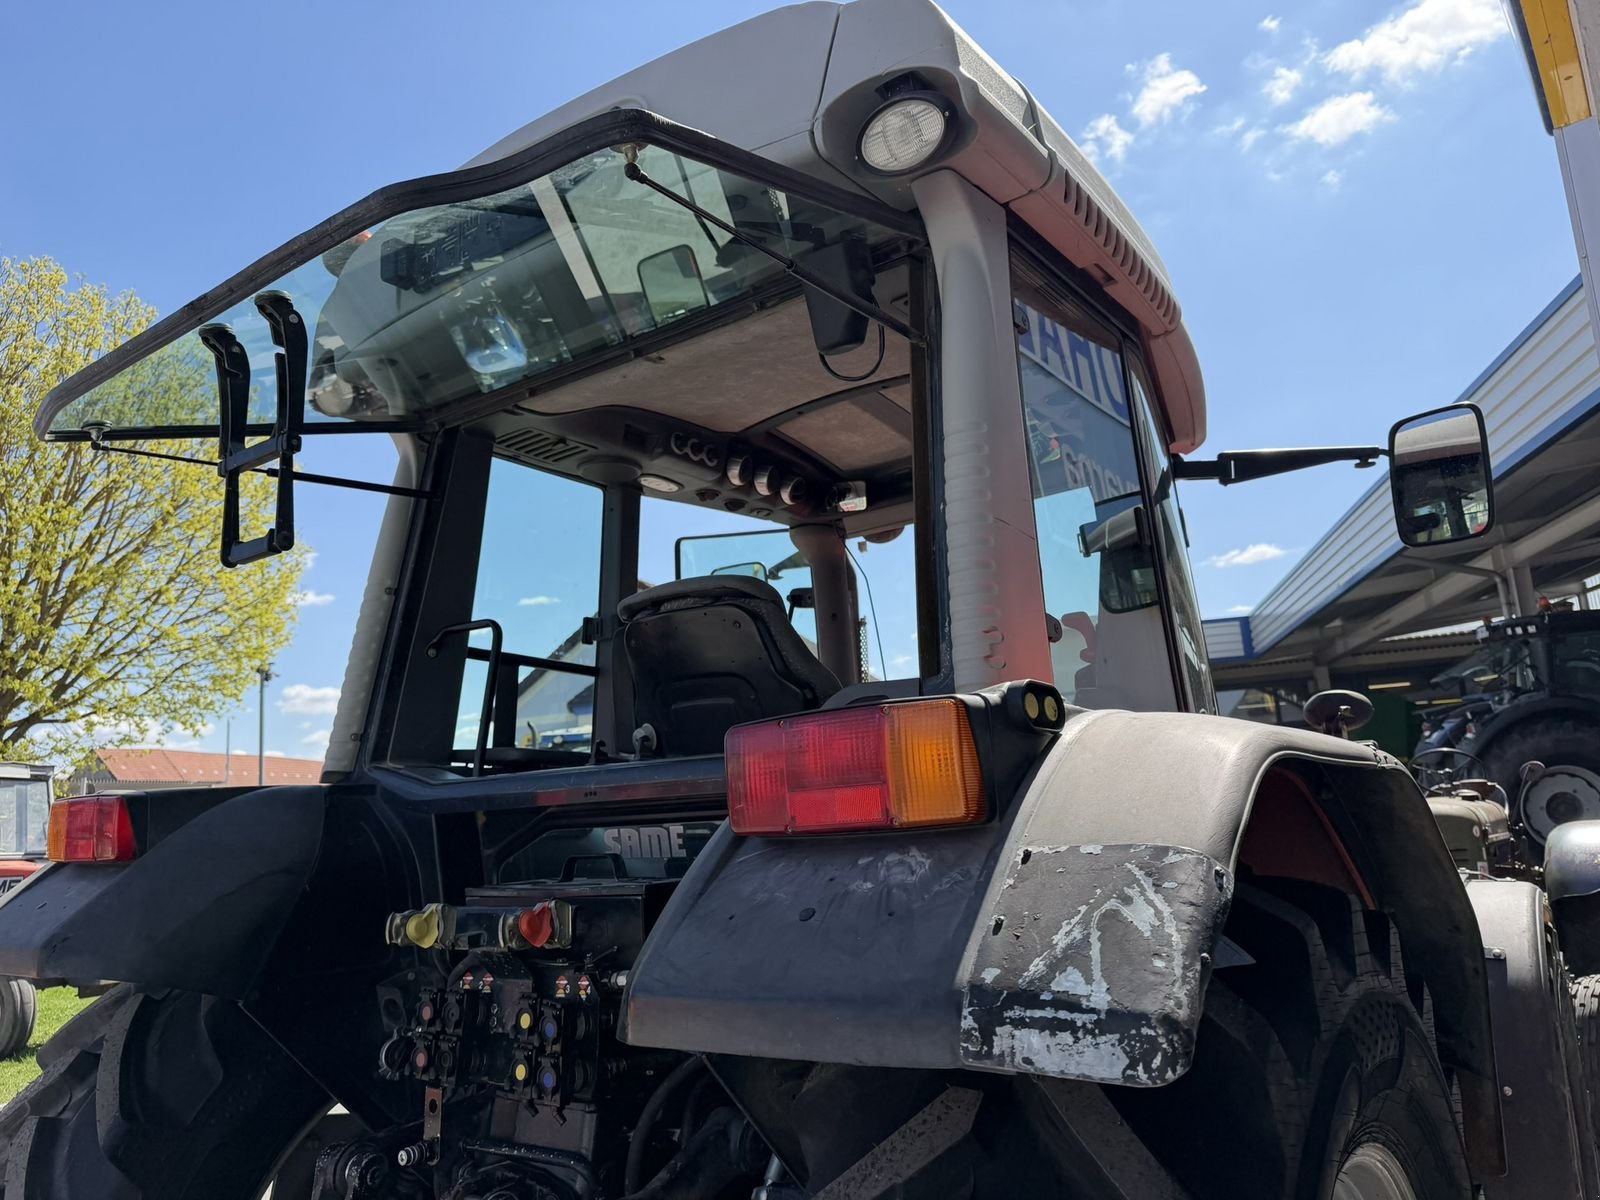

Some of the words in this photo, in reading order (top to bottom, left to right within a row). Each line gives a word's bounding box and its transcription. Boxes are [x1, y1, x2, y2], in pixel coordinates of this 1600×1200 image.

[604, 825, 687, 858] SAME
[478, 981, 483, 989] 2
[565, 984, 570, 994] 3
[586, 985, 591, 995] 4
